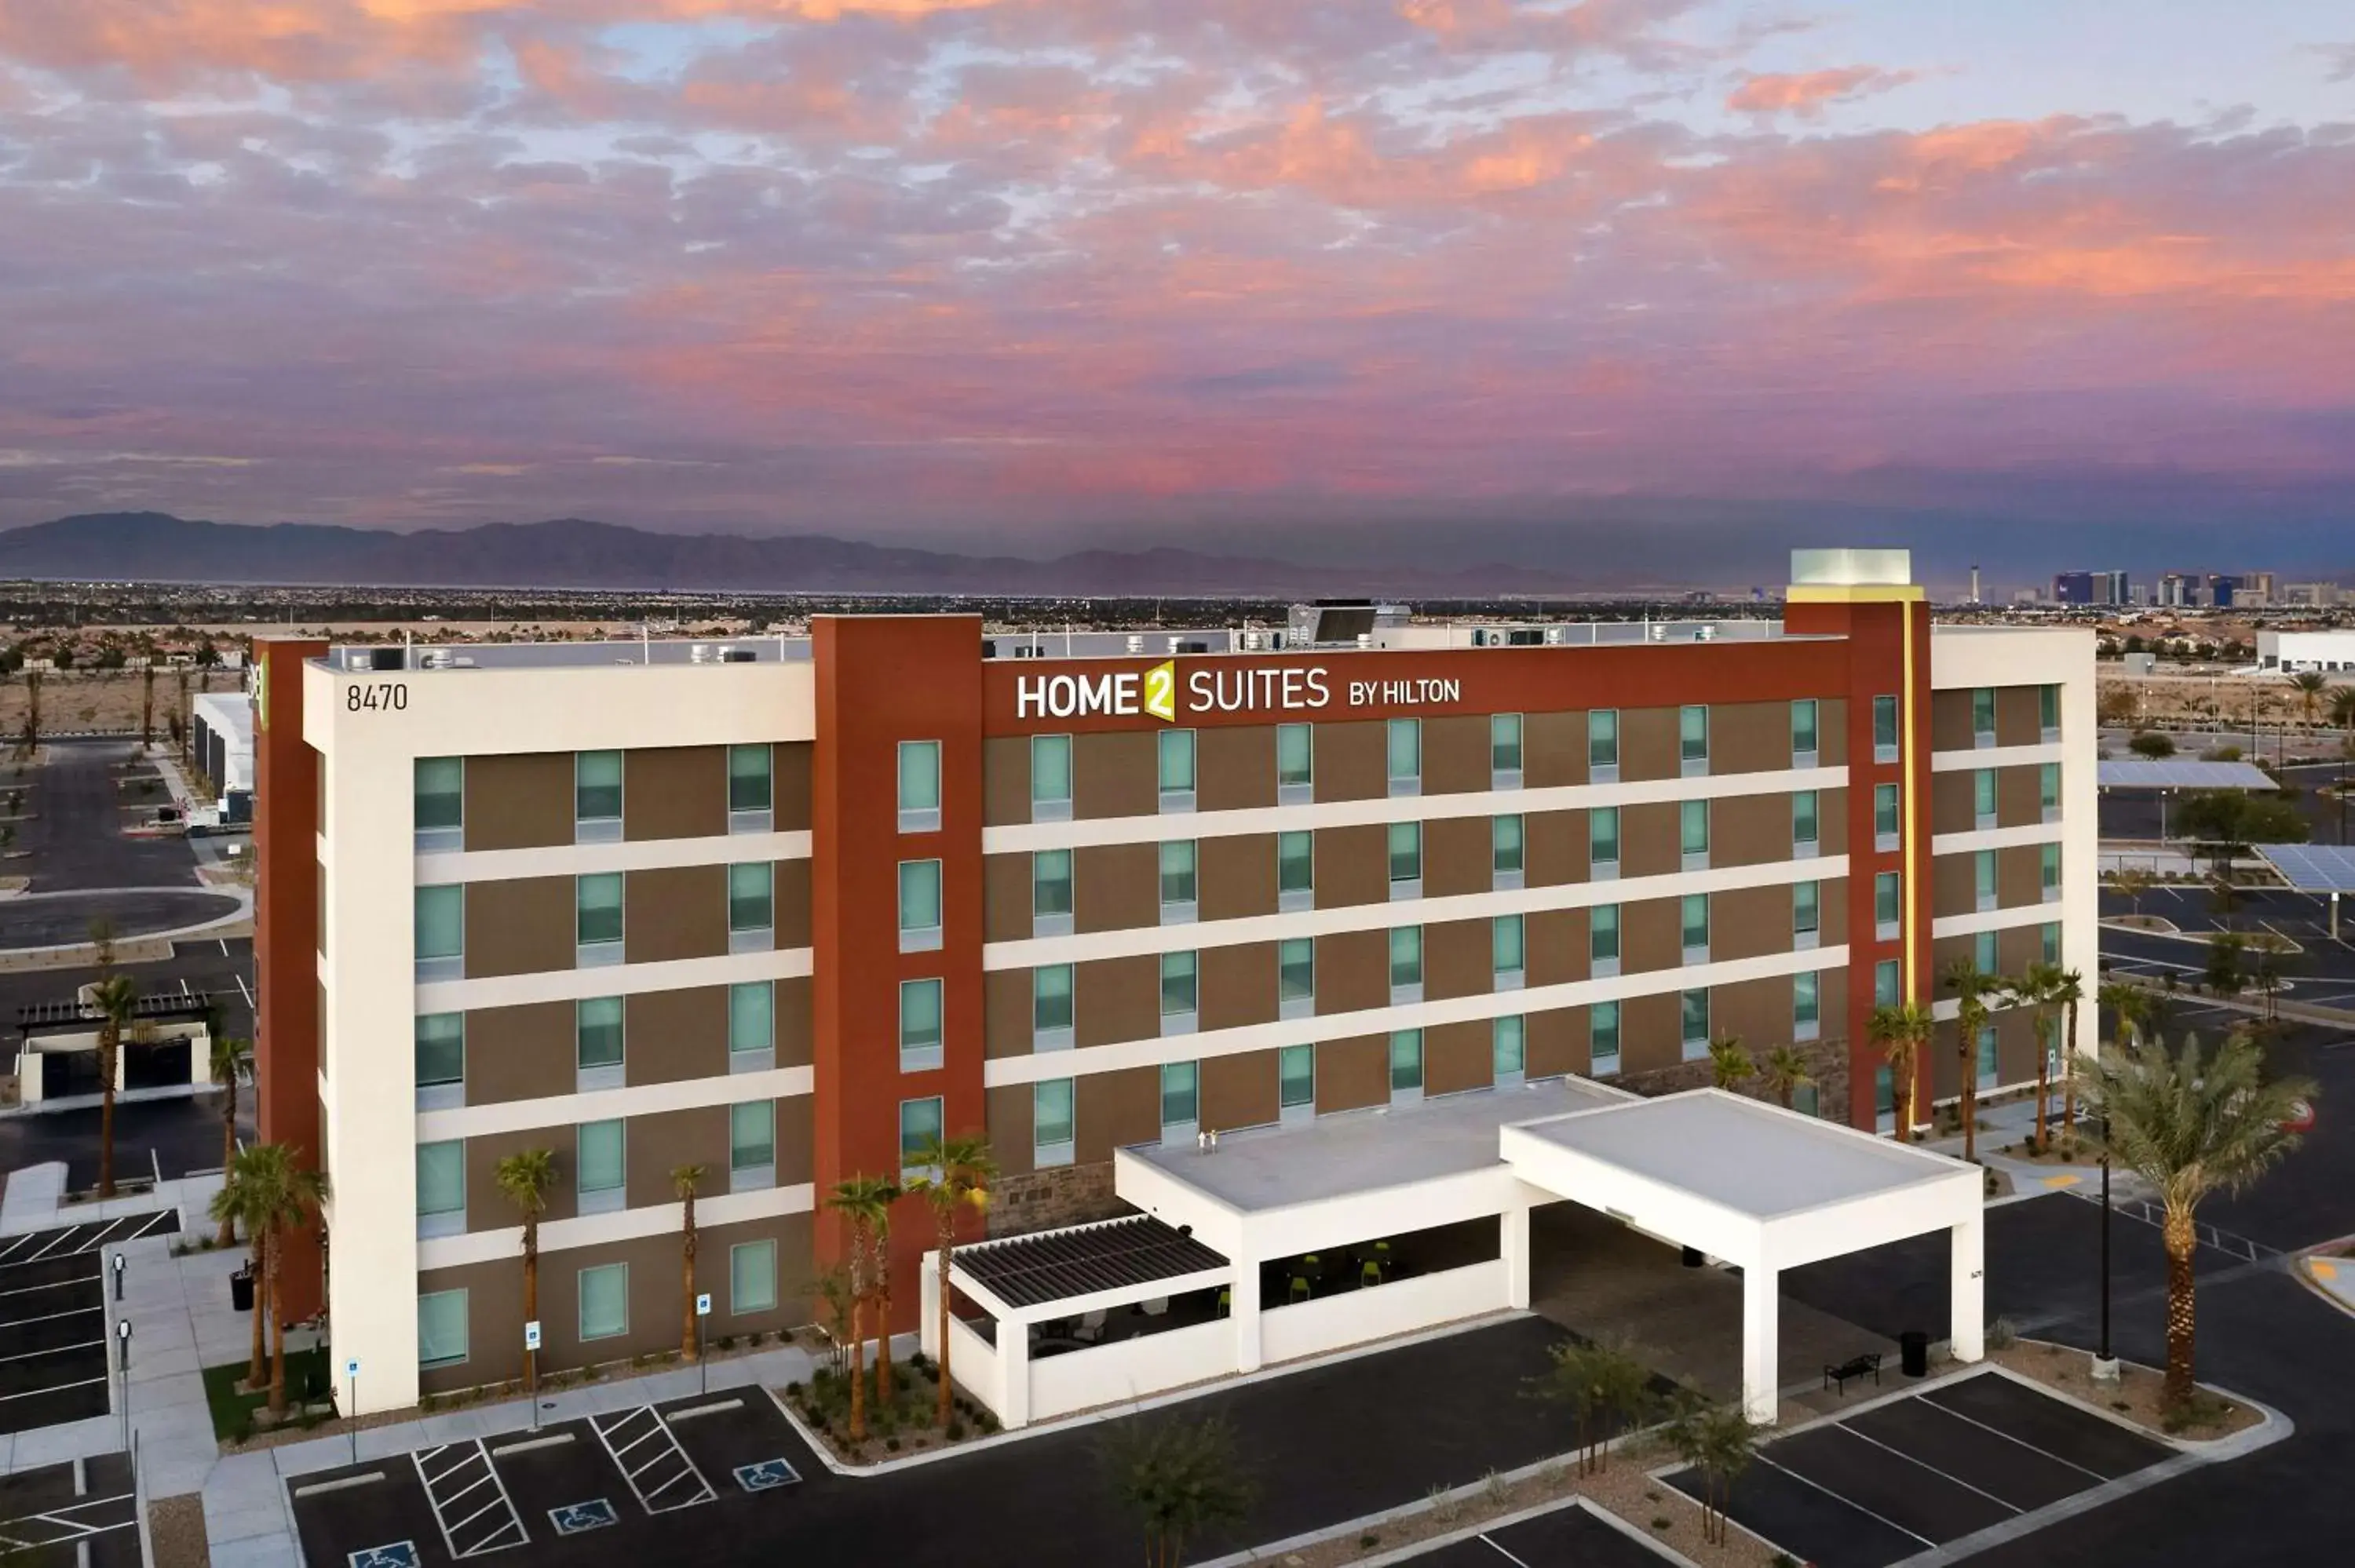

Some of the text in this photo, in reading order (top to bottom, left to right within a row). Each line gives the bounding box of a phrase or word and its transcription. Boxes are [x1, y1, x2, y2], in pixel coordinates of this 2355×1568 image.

[348, 684, 407, 712] 8470
[1018, 673, 1139, 718] HOME
[1189, 668, 1330, 712] SUITES
[1349, 681, 1378, 706] BY
[1383, 679, 1460, 704] HILTON
